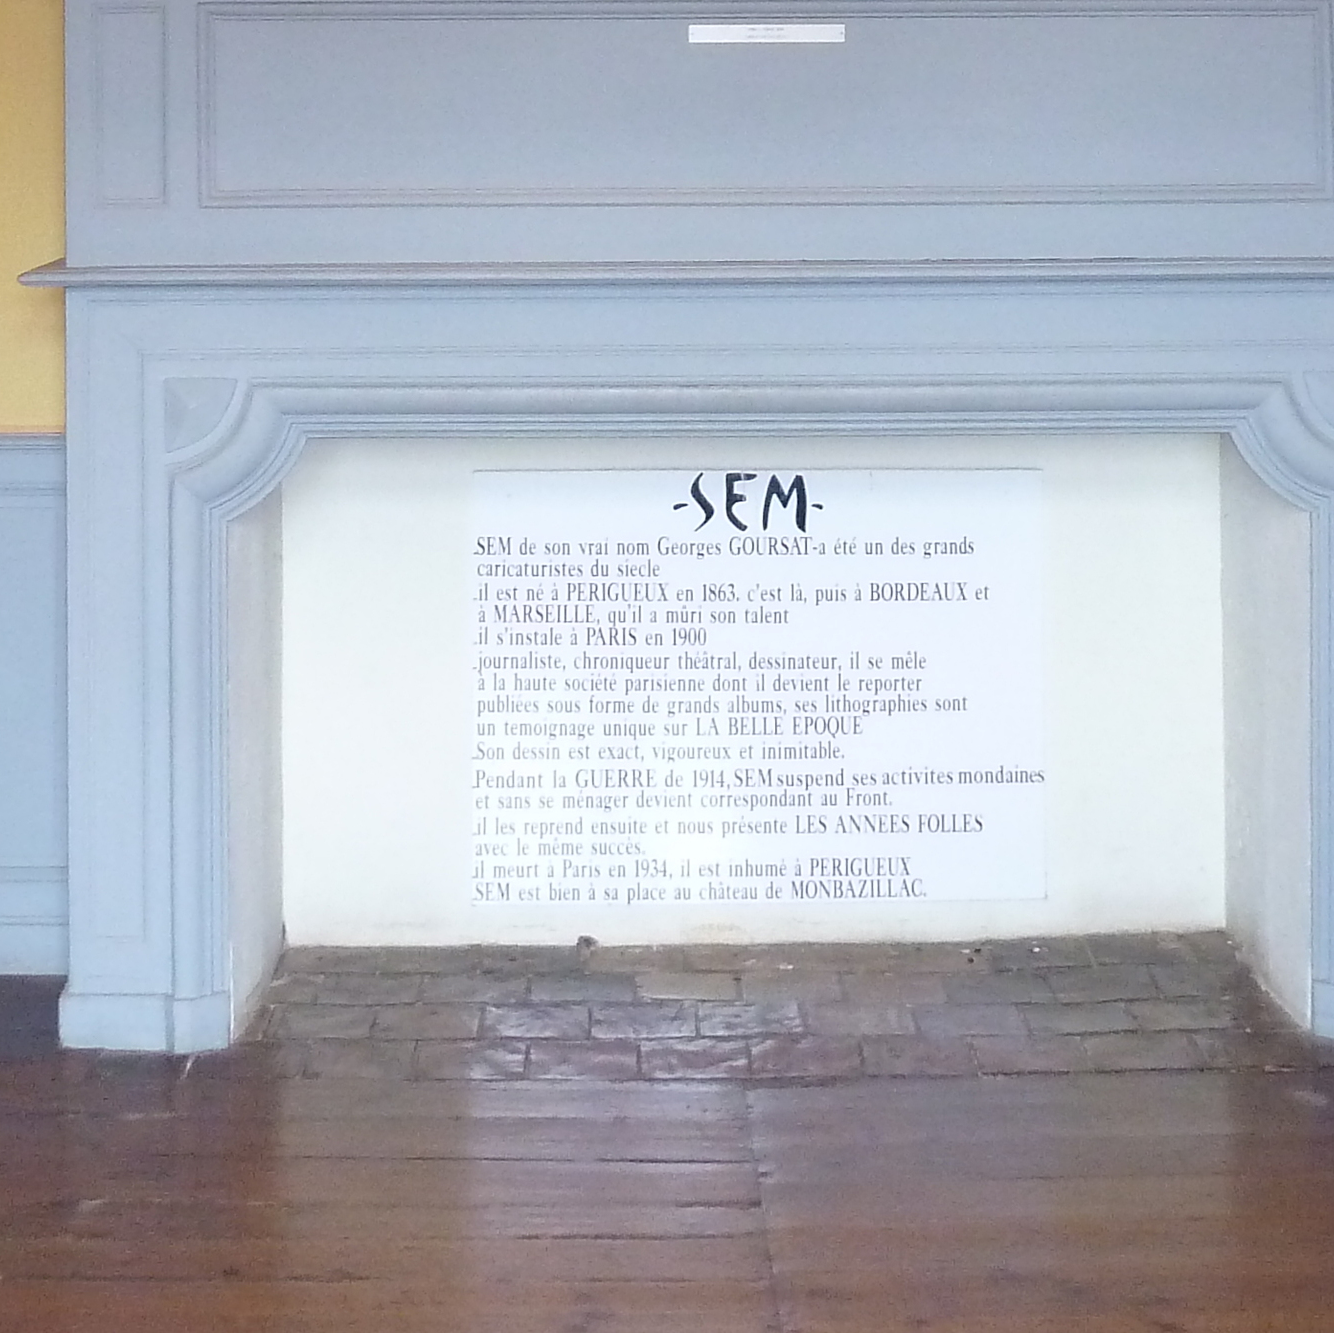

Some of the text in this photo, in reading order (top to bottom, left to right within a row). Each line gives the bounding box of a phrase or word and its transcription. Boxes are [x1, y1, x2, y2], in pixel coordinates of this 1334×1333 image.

[519, 537, 537, 556] de
[544, 542, 571, 556] son
[577, 536, 609, 556] vrai
[616, 542, 650, 556] nom
[657, 536, 722, 560] Georges
[833, 536, 857, 556] été
[864, 542, 884, 556] un
[890, 536, 916, 556] des
[923, 536, 975, 558] grands
[477, 560, 584, 578] caricaturistes
[590, 558, 609, 578] du
[496, 587, 518, 602] est
[526, 584, 545, 602] né
[567, 582, 669, 602] PERIGUEUX
[676, 589, 694, 602] en
[747, 583, 782, 603] c'est
[790, 583, 807, 604] là,
[815, 584, 847, 607] puis
[869, 582, 967, 602] BORDEAUX
[975, 586, 990, 601] et
[493, 604, 600, 625] MARSEILLE,
[607, 604, 642, 628] qu'il
[665, 605, 702, 624] mûri
[710, 611, 737, 624] son
[744, 605, 789, 624] talent
[496, 627, 563, 646] s'instale
[586, 627, 637, 646] PARIS
[645, 633, 663, 646] en
[672, 627, 707, 646] 1900
[573, 650, 671, 674] chroniqueur
[677, 651, 742, 672] théâtral,
[849, 651, 860, 670] il
[867, 657, 883, 670] se
[891, 650, 927, 670] mêle
[493, 672, 506, 692] la
[513, 672, 557, 692] haute
[564, 673, 617, 692] société
[625, 674, 705, 696] parisienne
[712, 673, 747, 692] dont
[756, 673, 765, 692] il
[772, 673, 829, 692] devient
[837, 673, 851, 692] le
[858, 677, 923, 696] reporter
[547, 700, 581, 714] sous
[589, 694, 635, 714] forme
[641, 695, 659, 714] de
[667, 695, 720, 718] grands
[727, 694, 787, 715] albums,
[794, 701, 818, 713] ses
[825, 693, 928, 717] lithographies
[935, 697, 968, 712] sont
[476, 723, 496, 736] un
[603, 718, 656, 741] unique
[663, 724, 689, 737] sur
[696, 717, 721, 736] LA
[728, 716, 785, 736] BELLE
[792, 716, 863, 740] EPOQUE
[512, 741, 561, 760] dessin
[568, 746, 590, 760] est
[597, 745, 645, 762] exact,
[652, 742, 731, 764] vigoureux
[739, 745, 753, 760] et
[761, 740, 845, 760] inimitable.
[553, 770, 567, 789] la
[575, 768, 657, 789] GUERRE
[663, 768, 684, 788] de
[732, 768, 773, 788] SEM
[777, 768, 845, 792] suspend
[852, 774, 877, 786] ses
[958, 764, 1045, 785] mondaines
[475, 787, 893, 812] et sans se ménager devient correspondant au Front.
[495, 817, 516, 836] les
[523, 816, 583, 840] reprend
[591, 816, 647, 835] ensuite
[654, 820, 669, 835] et
[677, 821, 714, 835] nous
[721, 816, 788, 839] présente
[795, 814, 827, 835] LES
[834, 814, 910, 834] ANNEES
[917, 814, 983, 834] FOLLES
[475, 843, 509, 857] avec
[517, 837, 529, 857] le
[537, 836, 583, 856] même
[493, 864, 539, 879] meurt
[562, 859, 601, 878] Paris
[608, 864, 626, 878] en
[635, 858, 673, 879] 1934,
[680, 858, 691, 878] il
[698, 863, 720, 878] est
[729, 858, 787, 878] inhumé
[809, 856, 911, 877] PERIGUEUX
[518, 886, 541, 902] est
[549, 882, 581, 902] bien
[603, 888, 619, 901] sa
[627, 882, 667, 906] place
[673, 887, 691, 901] au
[698, 881, 759, 901] château
[765, 881, 783, 900] de
[791, 878, 927, 900] MONBAZILLAC.
